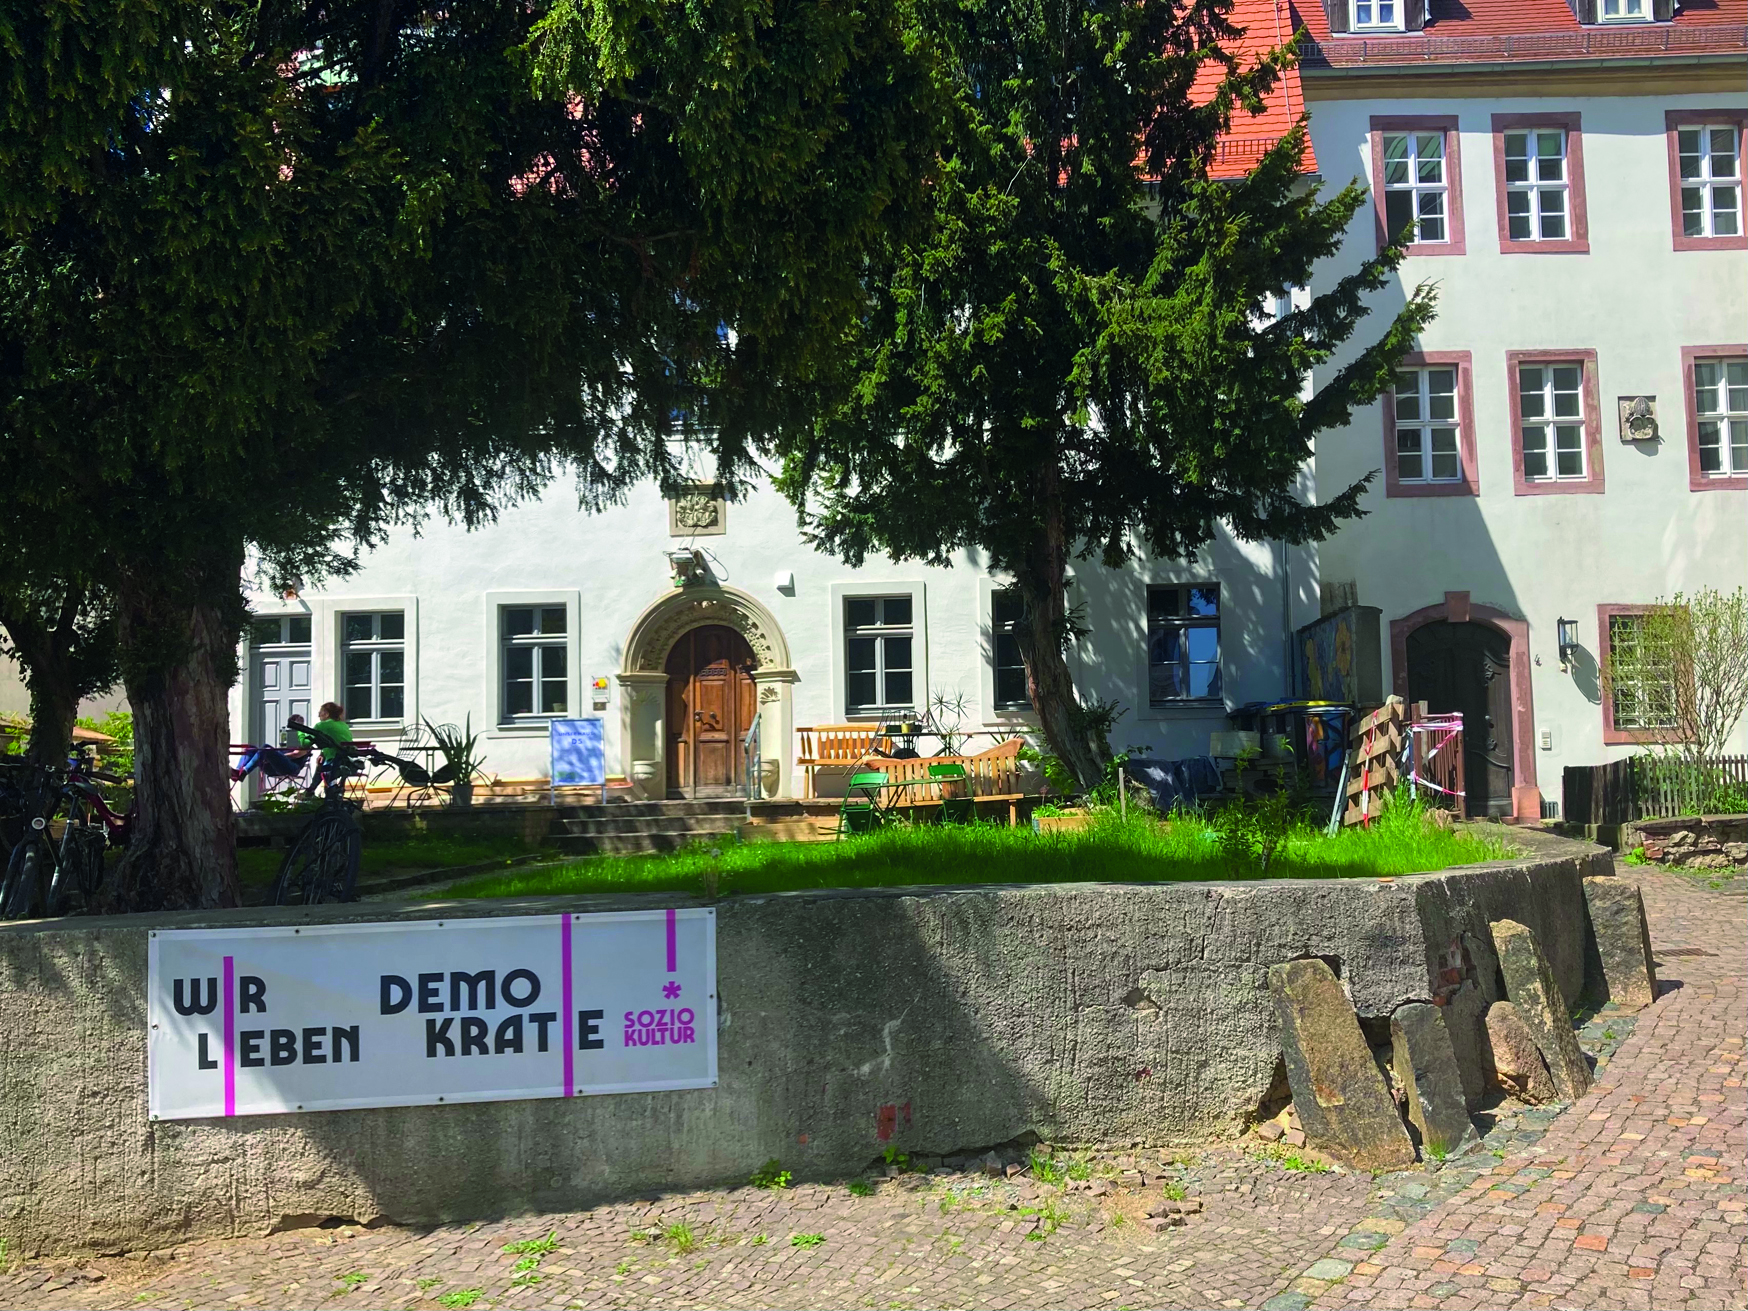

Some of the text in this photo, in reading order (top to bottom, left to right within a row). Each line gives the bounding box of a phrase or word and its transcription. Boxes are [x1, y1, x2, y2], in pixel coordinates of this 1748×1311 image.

[380, 968, 541, 1016] DEMO
[624, 1007, 695, 1029] SOZIO
[624, 1026, 696, 1047] KULTUR
